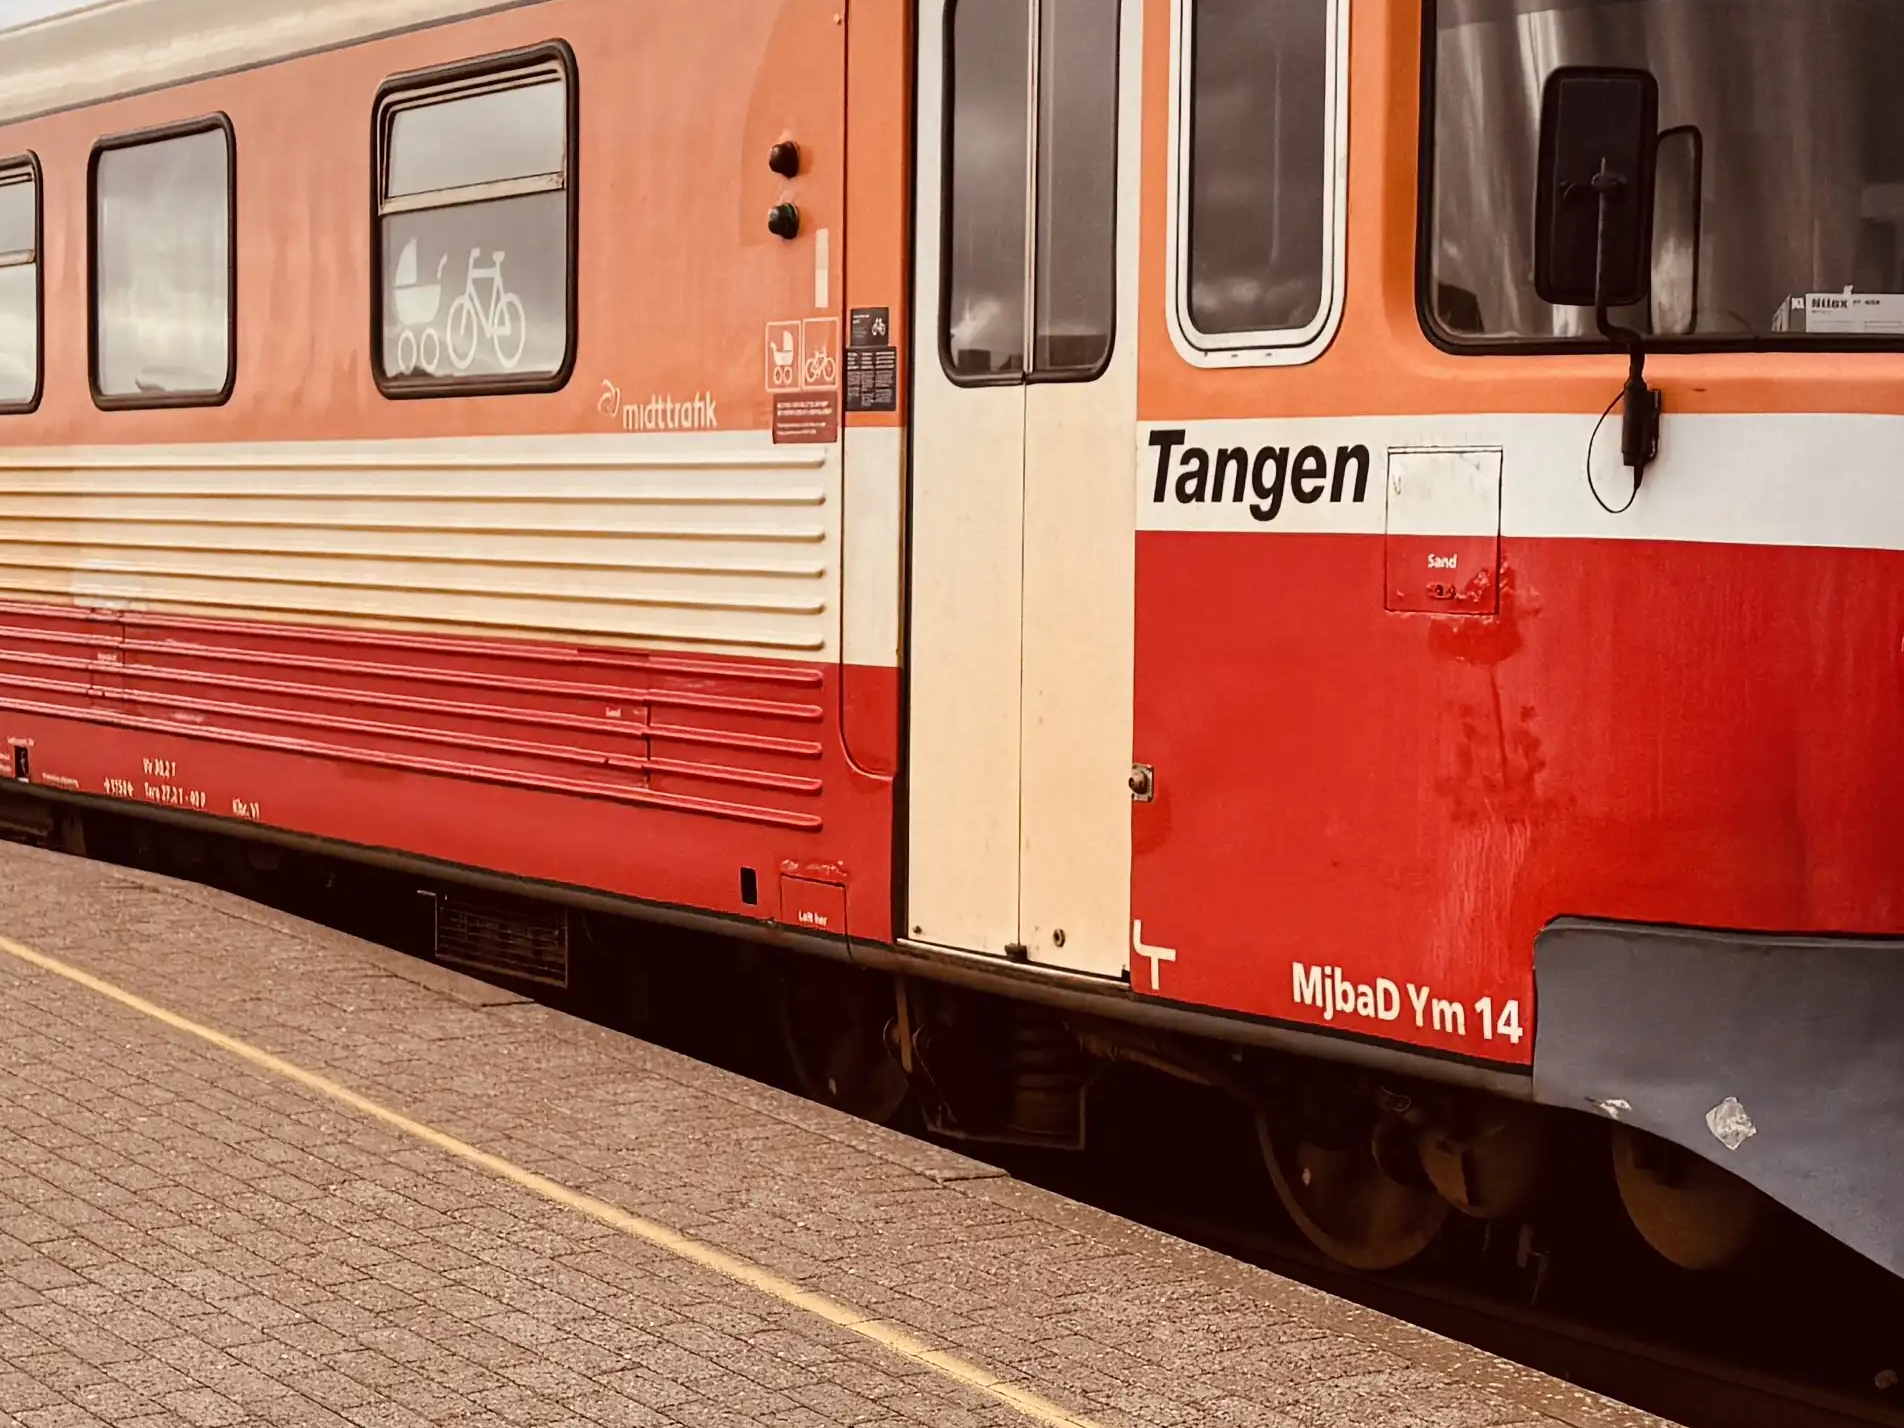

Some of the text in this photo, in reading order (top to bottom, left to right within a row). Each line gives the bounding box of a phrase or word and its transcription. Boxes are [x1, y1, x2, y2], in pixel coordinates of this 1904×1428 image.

[1148, 428, 1370, 522] Tangen
[1427, 552, 1458, 569] Sand
[1292, 961, 1524, 1045] MjbaD Ym 14
